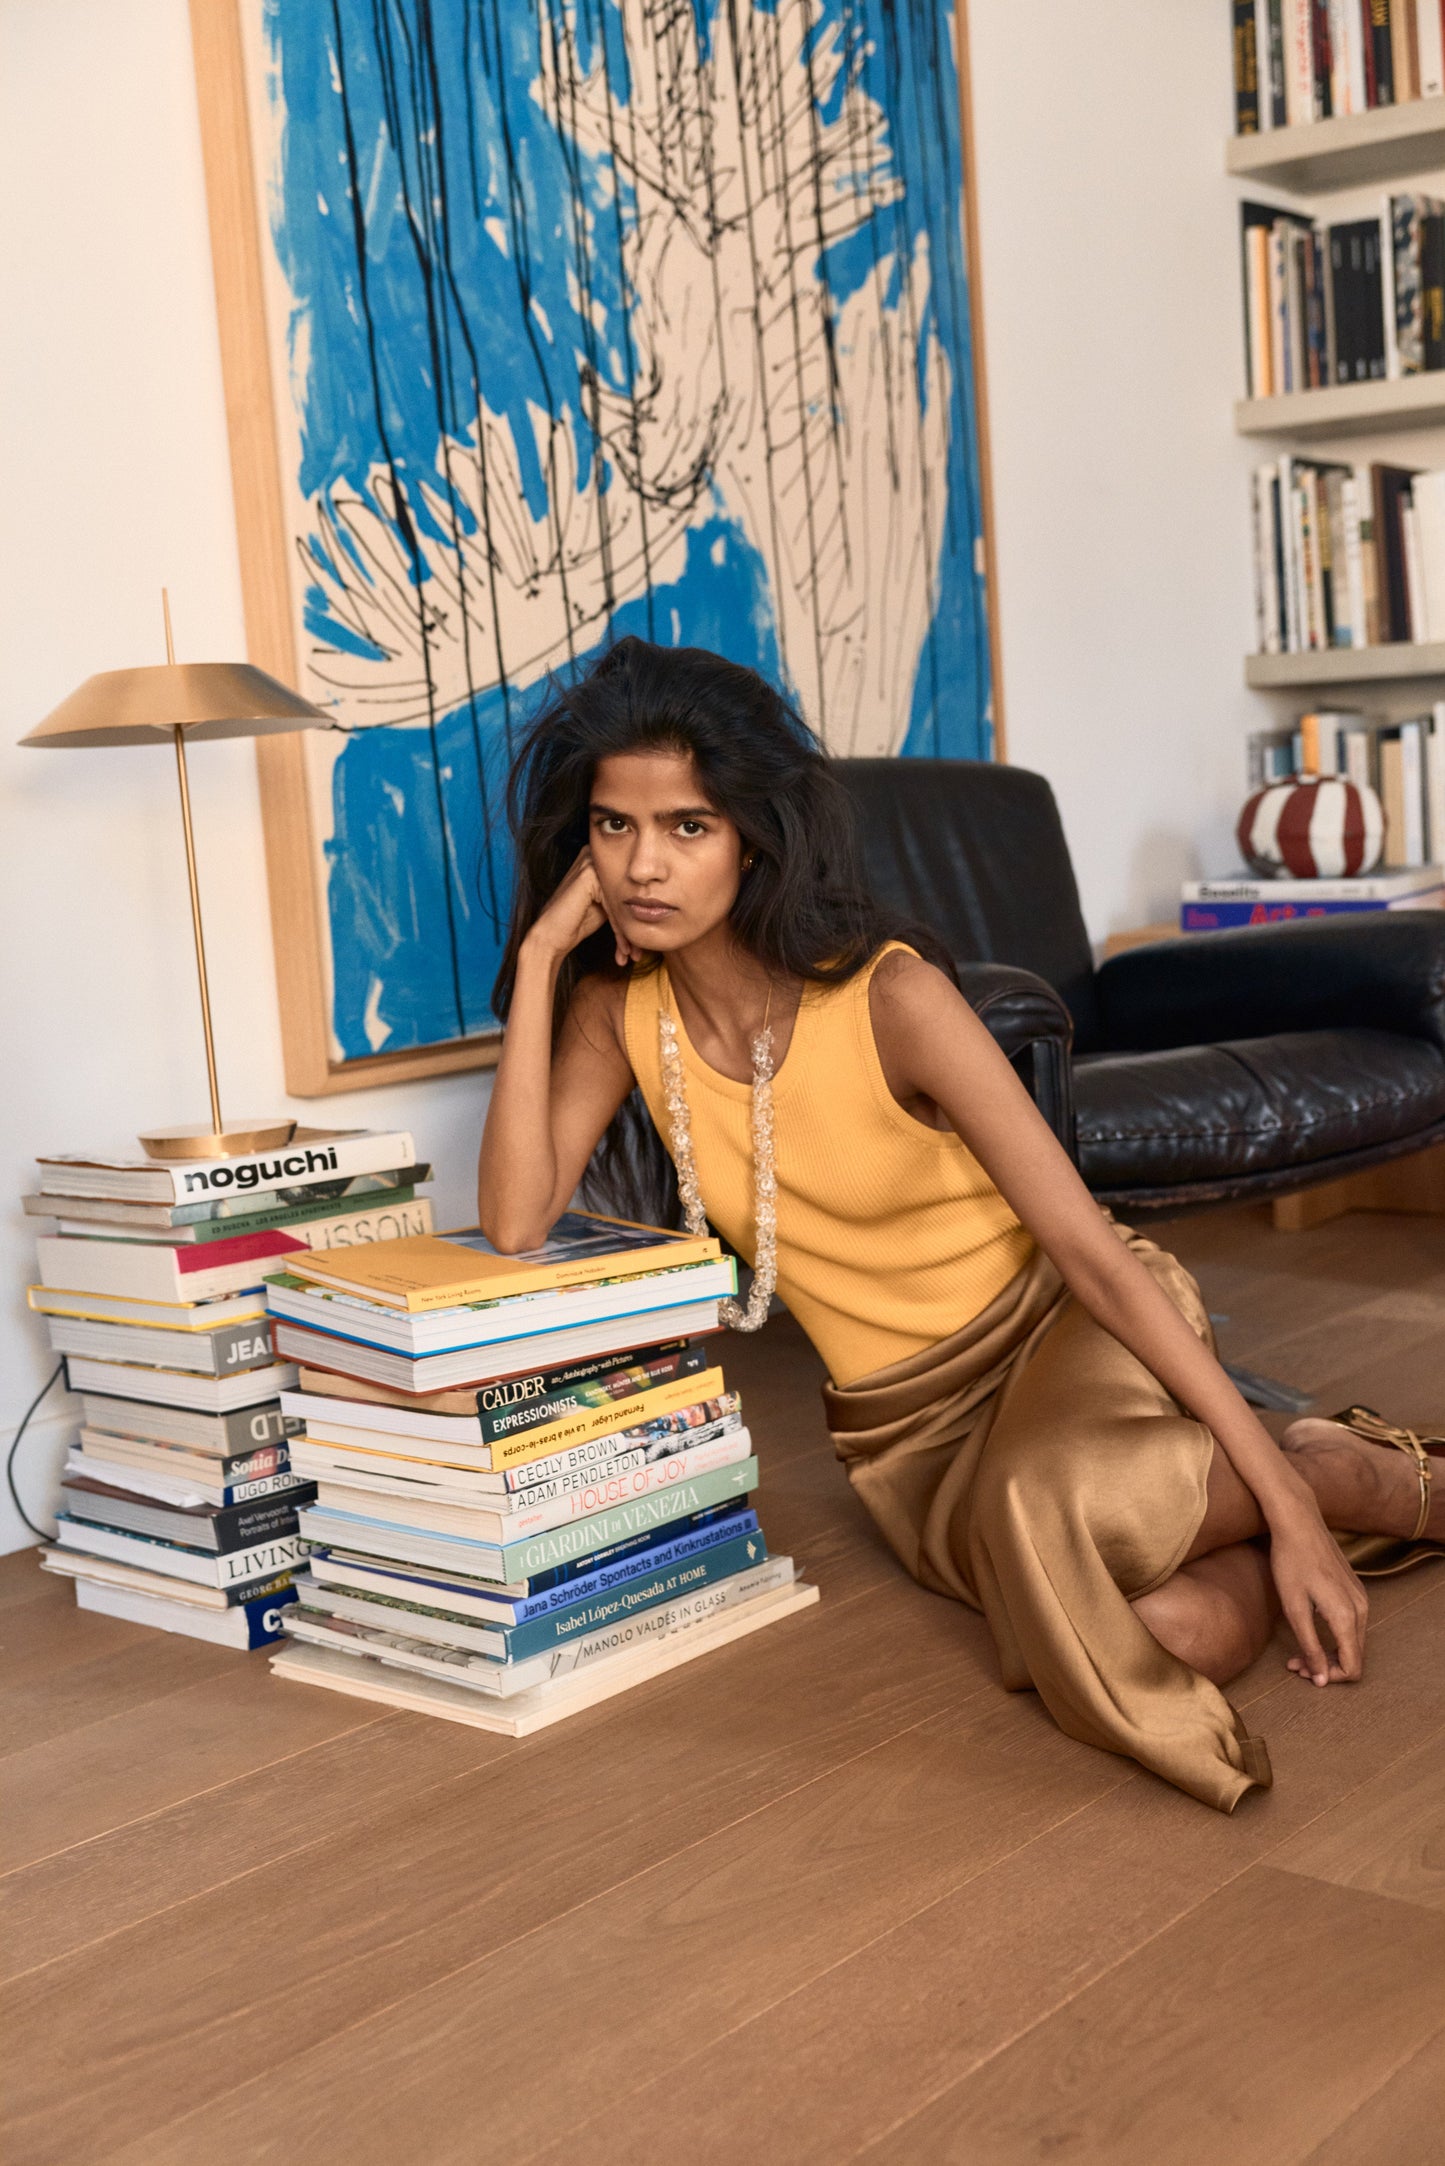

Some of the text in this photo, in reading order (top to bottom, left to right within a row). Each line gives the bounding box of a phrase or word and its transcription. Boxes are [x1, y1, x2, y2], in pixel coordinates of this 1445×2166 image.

[184, 1147, 338, 1192] noguchi
[482, 1376, 547, 1411] CALDER
[614, 1404, 645, 1420] Fernand
[250, 1410, 306, 1441] ELD
[493, 1395, 577, 1433] EXPRESSIONISTS
[564, 1428, 576, 1437] vie
[576, 1424, 586, 1432] La
[231, 1448, 290, 1477] Sonia D
[503, 1435, 557, 1457] bras-le-corps
[517, 1438, 618, 1485] CECILY BROWN
[238, 1480, 268, 1499] UGO
[517, 1453, 639, 1510] ADAM PENDLETON
[571, 1477, 629, 1514] HOUSE
[632, 1467, 654, 1492] OF
[657, 1456, 687, 1484] JOY
[526, 1518, 613, 1568] GIARDINI
[622, 1486, 700, 1531] VENEZIA
[228, 1540, 312, 1579] LIVING
[523, 1522, 743, 1618] Jana Schröder Spontacts and Kinkrustations
[239, 1582, 273, 1600] GEORG
[555, 1565, 707, 1635] Isabel López-Quesada AT HOME
[583, 1629, 633, 1658] MANOLO
[636, 1611, 676, 1635] VALDÉS
[679, 1605, 691, 1619] IN
[695, 1592, 726, 1613] GLASS
